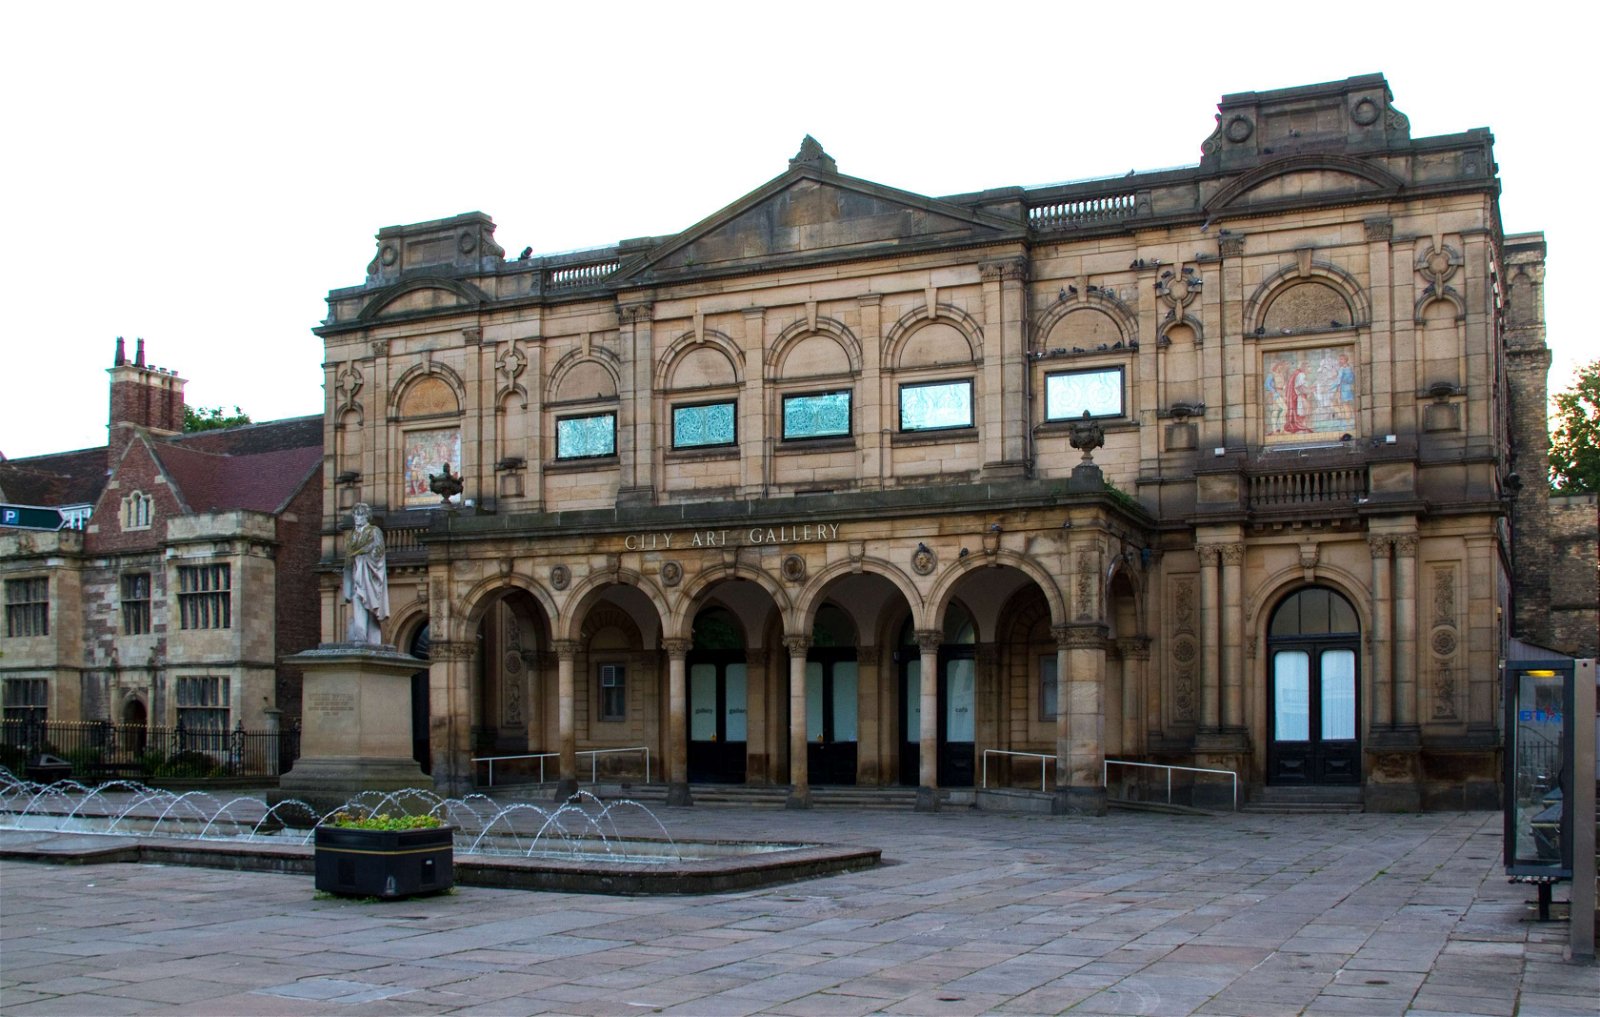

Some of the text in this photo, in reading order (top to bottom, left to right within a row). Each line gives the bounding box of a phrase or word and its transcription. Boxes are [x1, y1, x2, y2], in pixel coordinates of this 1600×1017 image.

[6, 510, 15, 521] P
[625, 523, 840, 550] CITY ART GALLERY
